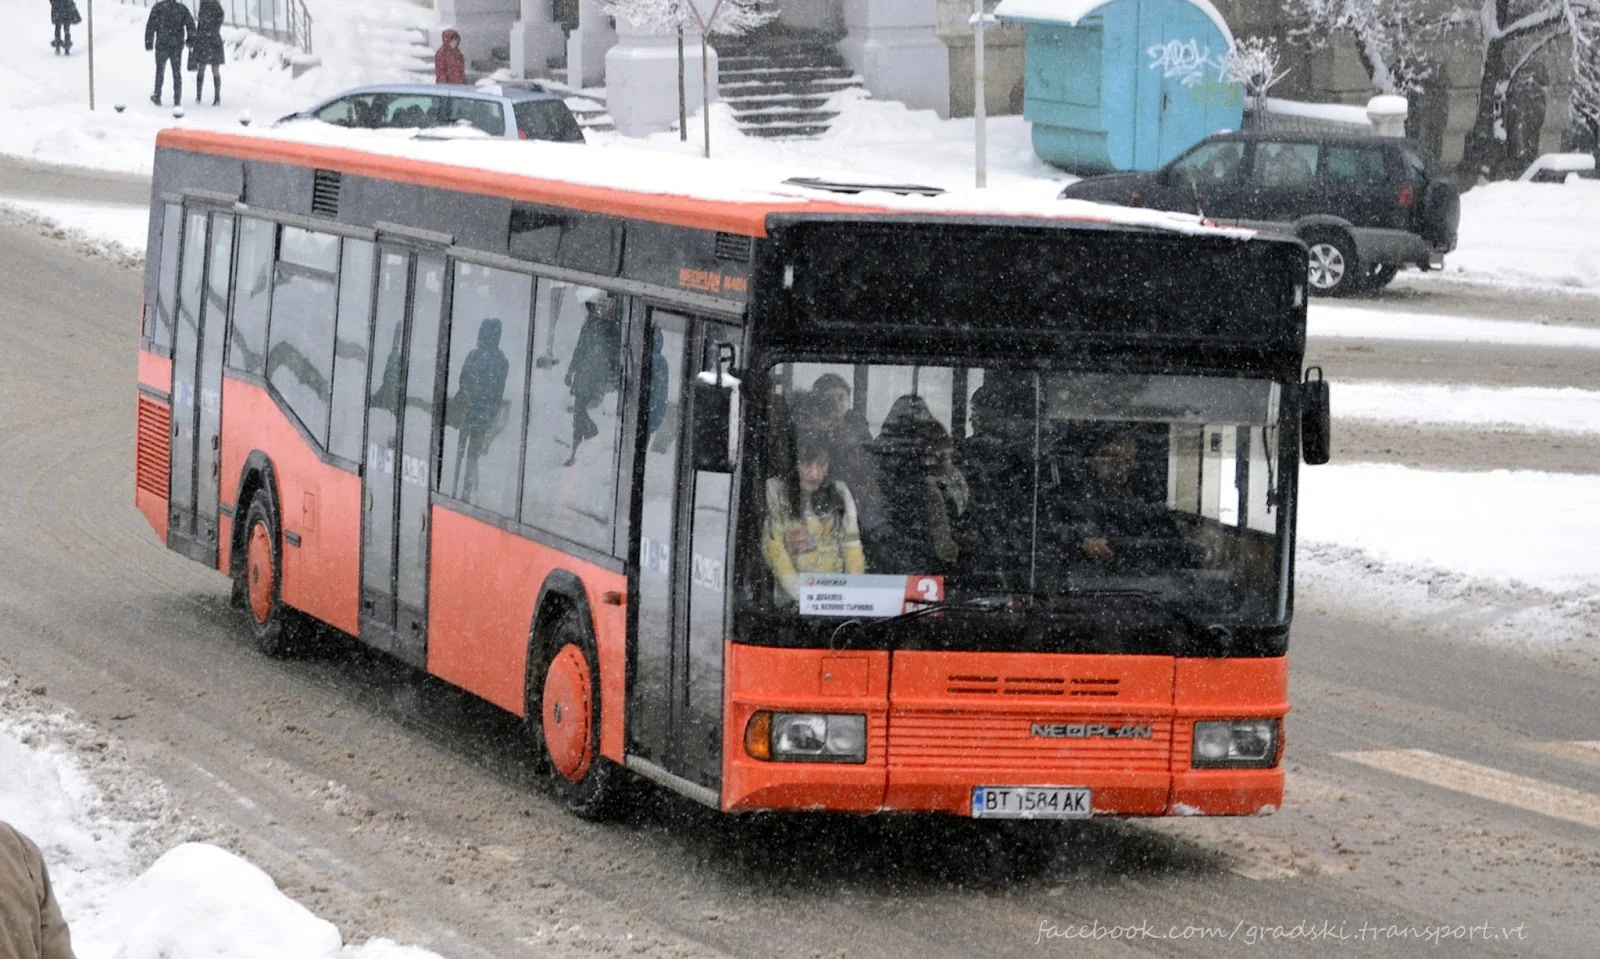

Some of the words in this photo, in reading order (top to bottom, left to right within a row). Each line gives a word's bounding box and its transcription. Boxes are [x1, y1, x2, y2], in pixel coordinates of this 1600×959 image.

[1030, 723, 1152, 739] NEOPLAN
[985, 791, 1011, 810] BT
[1016, 792, 1058, 811] 1584
[1062, 792, 1087, 811] AK
